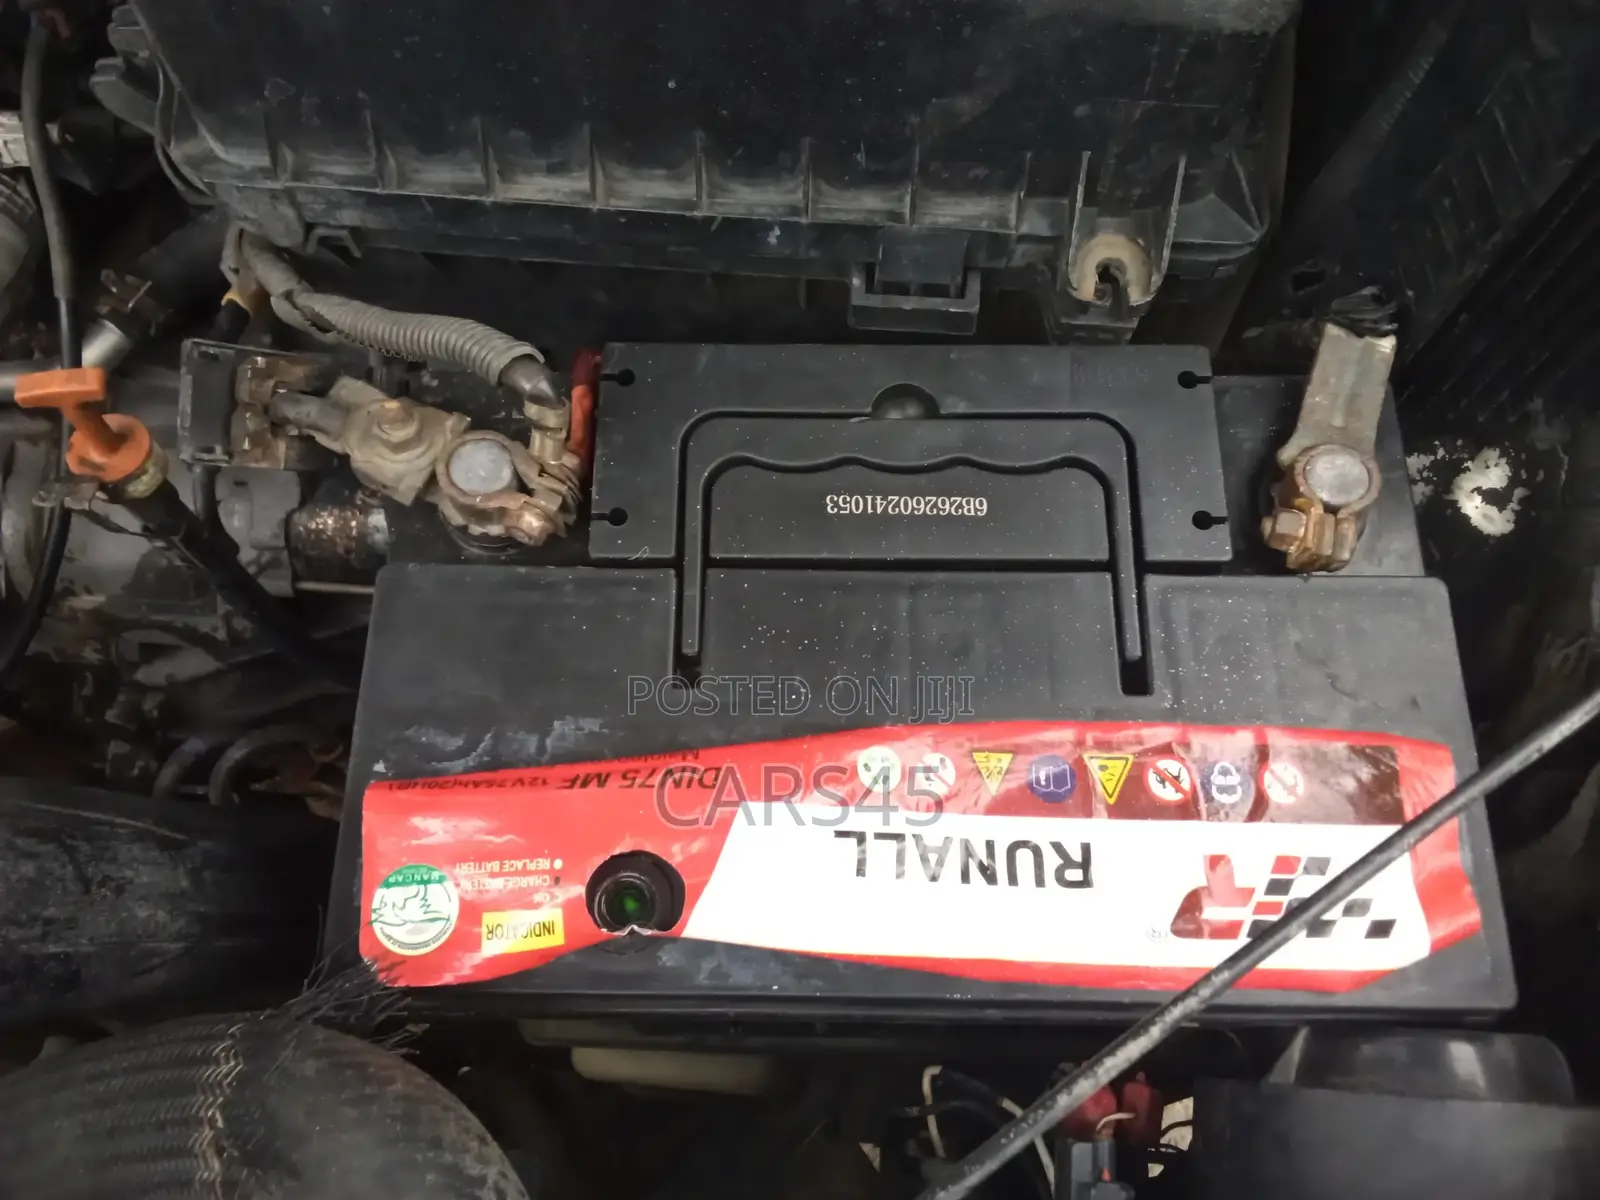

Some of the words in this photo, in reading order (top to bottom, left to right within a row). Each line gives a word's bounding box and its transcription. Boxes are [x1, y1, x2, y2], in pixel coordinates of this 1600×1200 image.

[825, 494, 988, 517] 6B26260241053
[555, 772, 612, 791] MF
[617, 766, 722, 791] DIN75
[455, 859, 500, 874] BATTERY
[502, 857, 551, 873] REPLACE
[833, 829, 1094, 889] RUNALL
[502, 874, 551, 890] CHARGE
[486, 919, 556, 941] INDICATOR
